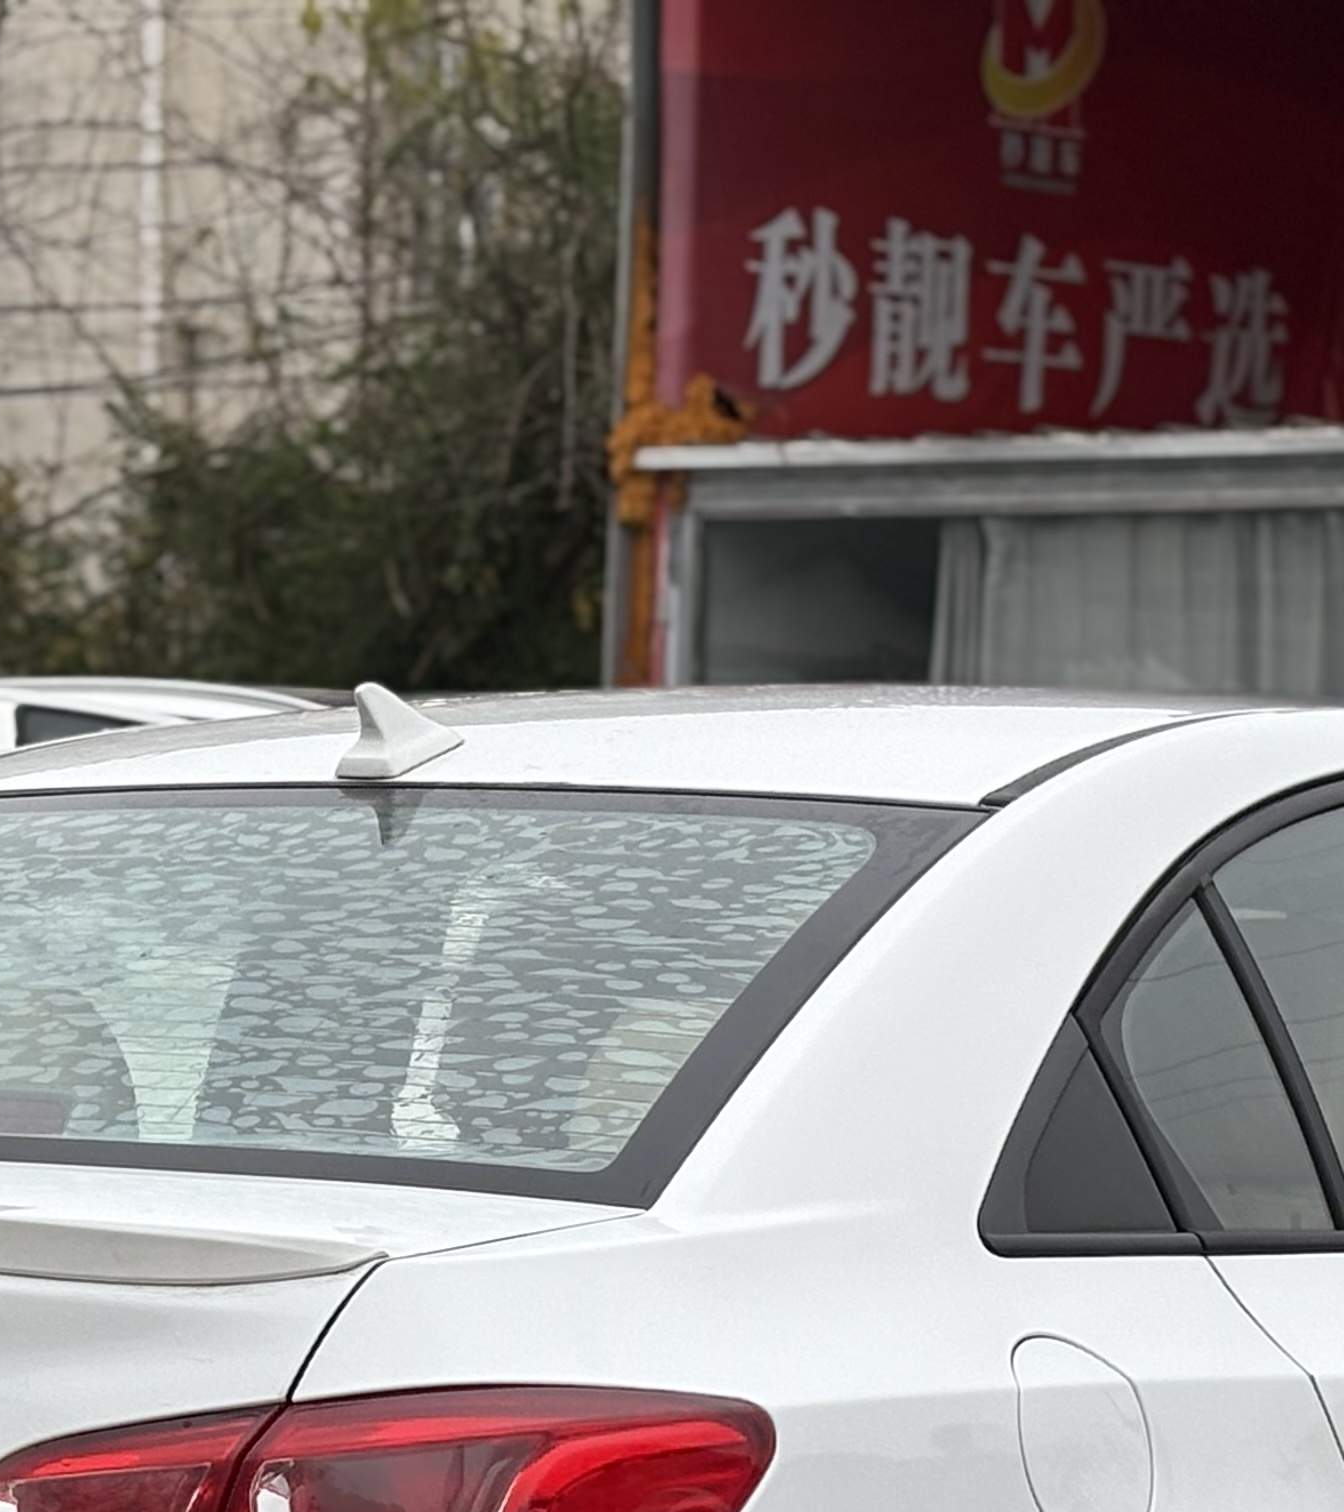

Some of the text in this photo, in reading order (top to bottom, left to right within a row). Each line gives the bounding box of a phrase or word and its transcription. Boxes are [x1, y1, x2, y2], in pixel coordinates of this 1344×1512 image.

[742, 206, 1289, 426] 秒靓车严选
